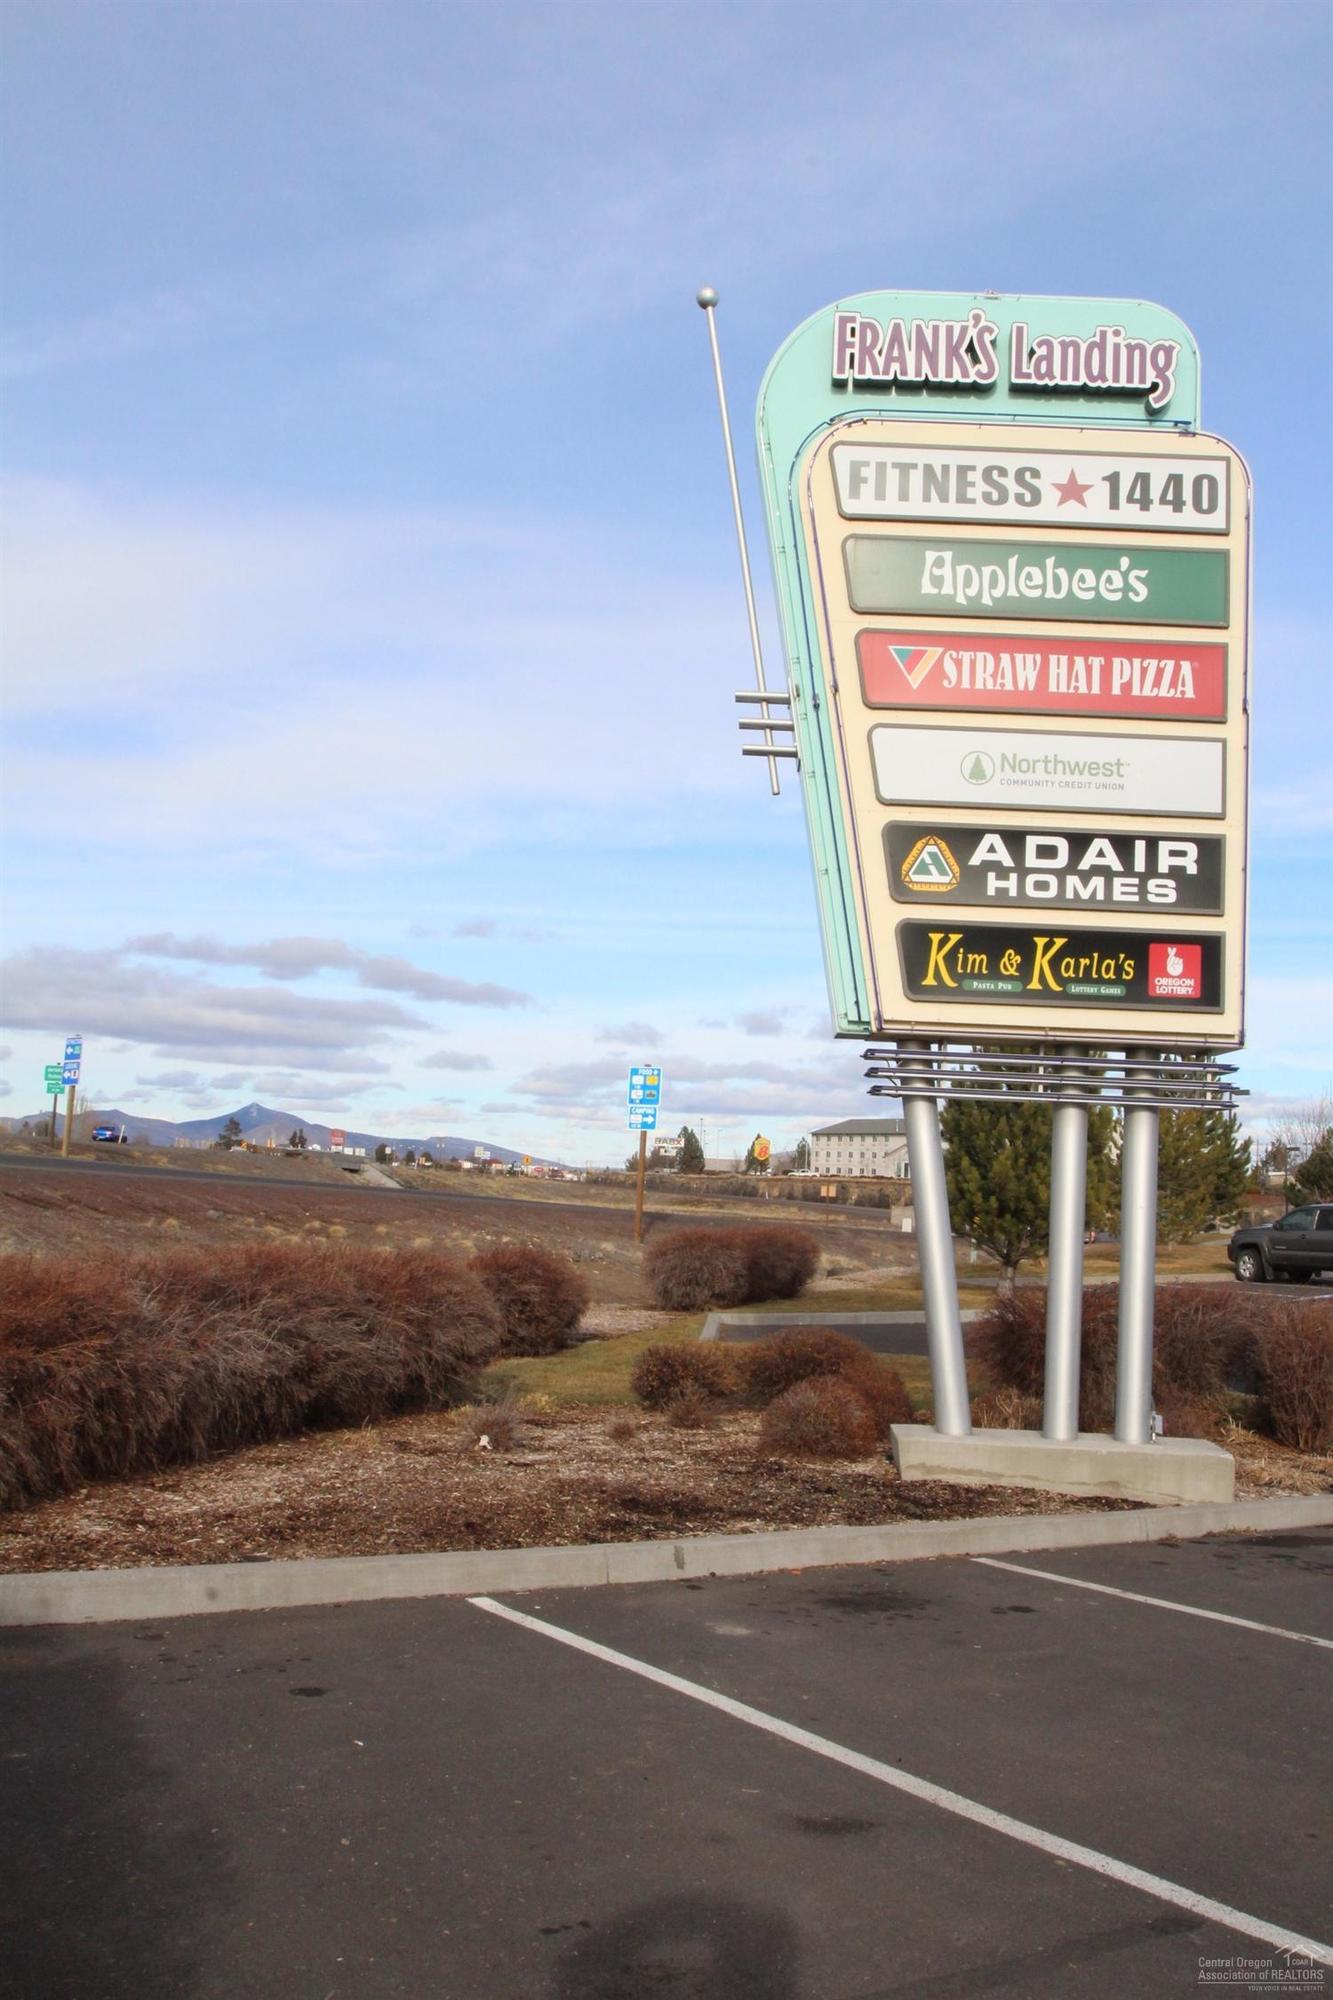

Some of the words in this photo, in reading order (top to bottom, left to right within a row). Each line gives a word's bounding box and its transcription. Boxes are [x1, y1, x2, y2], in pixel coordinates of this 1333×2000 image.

[833, 309, 998, 383] FRANK'S
[1011, 322, 1180, 407] Landing
[847, 459, 1042, 507] FITNESS
[1102, 470, 1219, 515] 1440
[921, 550, 1149, 606] Applebee's
[943, 650, 1041, 691] STRAW
[1049, 654, 1105, 694] HAT
[1111, 657, 1196, 698] PIZZA
[1000, 778, 1055, 788] COMMUNITY
[1058, 780, 1092, 790] CREDIT
[1095, 782, 1125, 791] UNION
[1001, 752, 1125, 778] Northwest
[968, 833, 1199, 875] ADAIR
[987, 871, 1178, 904] HOMES
[921, 932, 989, 988] Kim
[1000, 948, 1021, 976] &
[1026, 937, 1136, 992] Karla's
[1155, 977, 1195, 986] OREGON
[1156, 986, 1195, 995] LOTTERY
